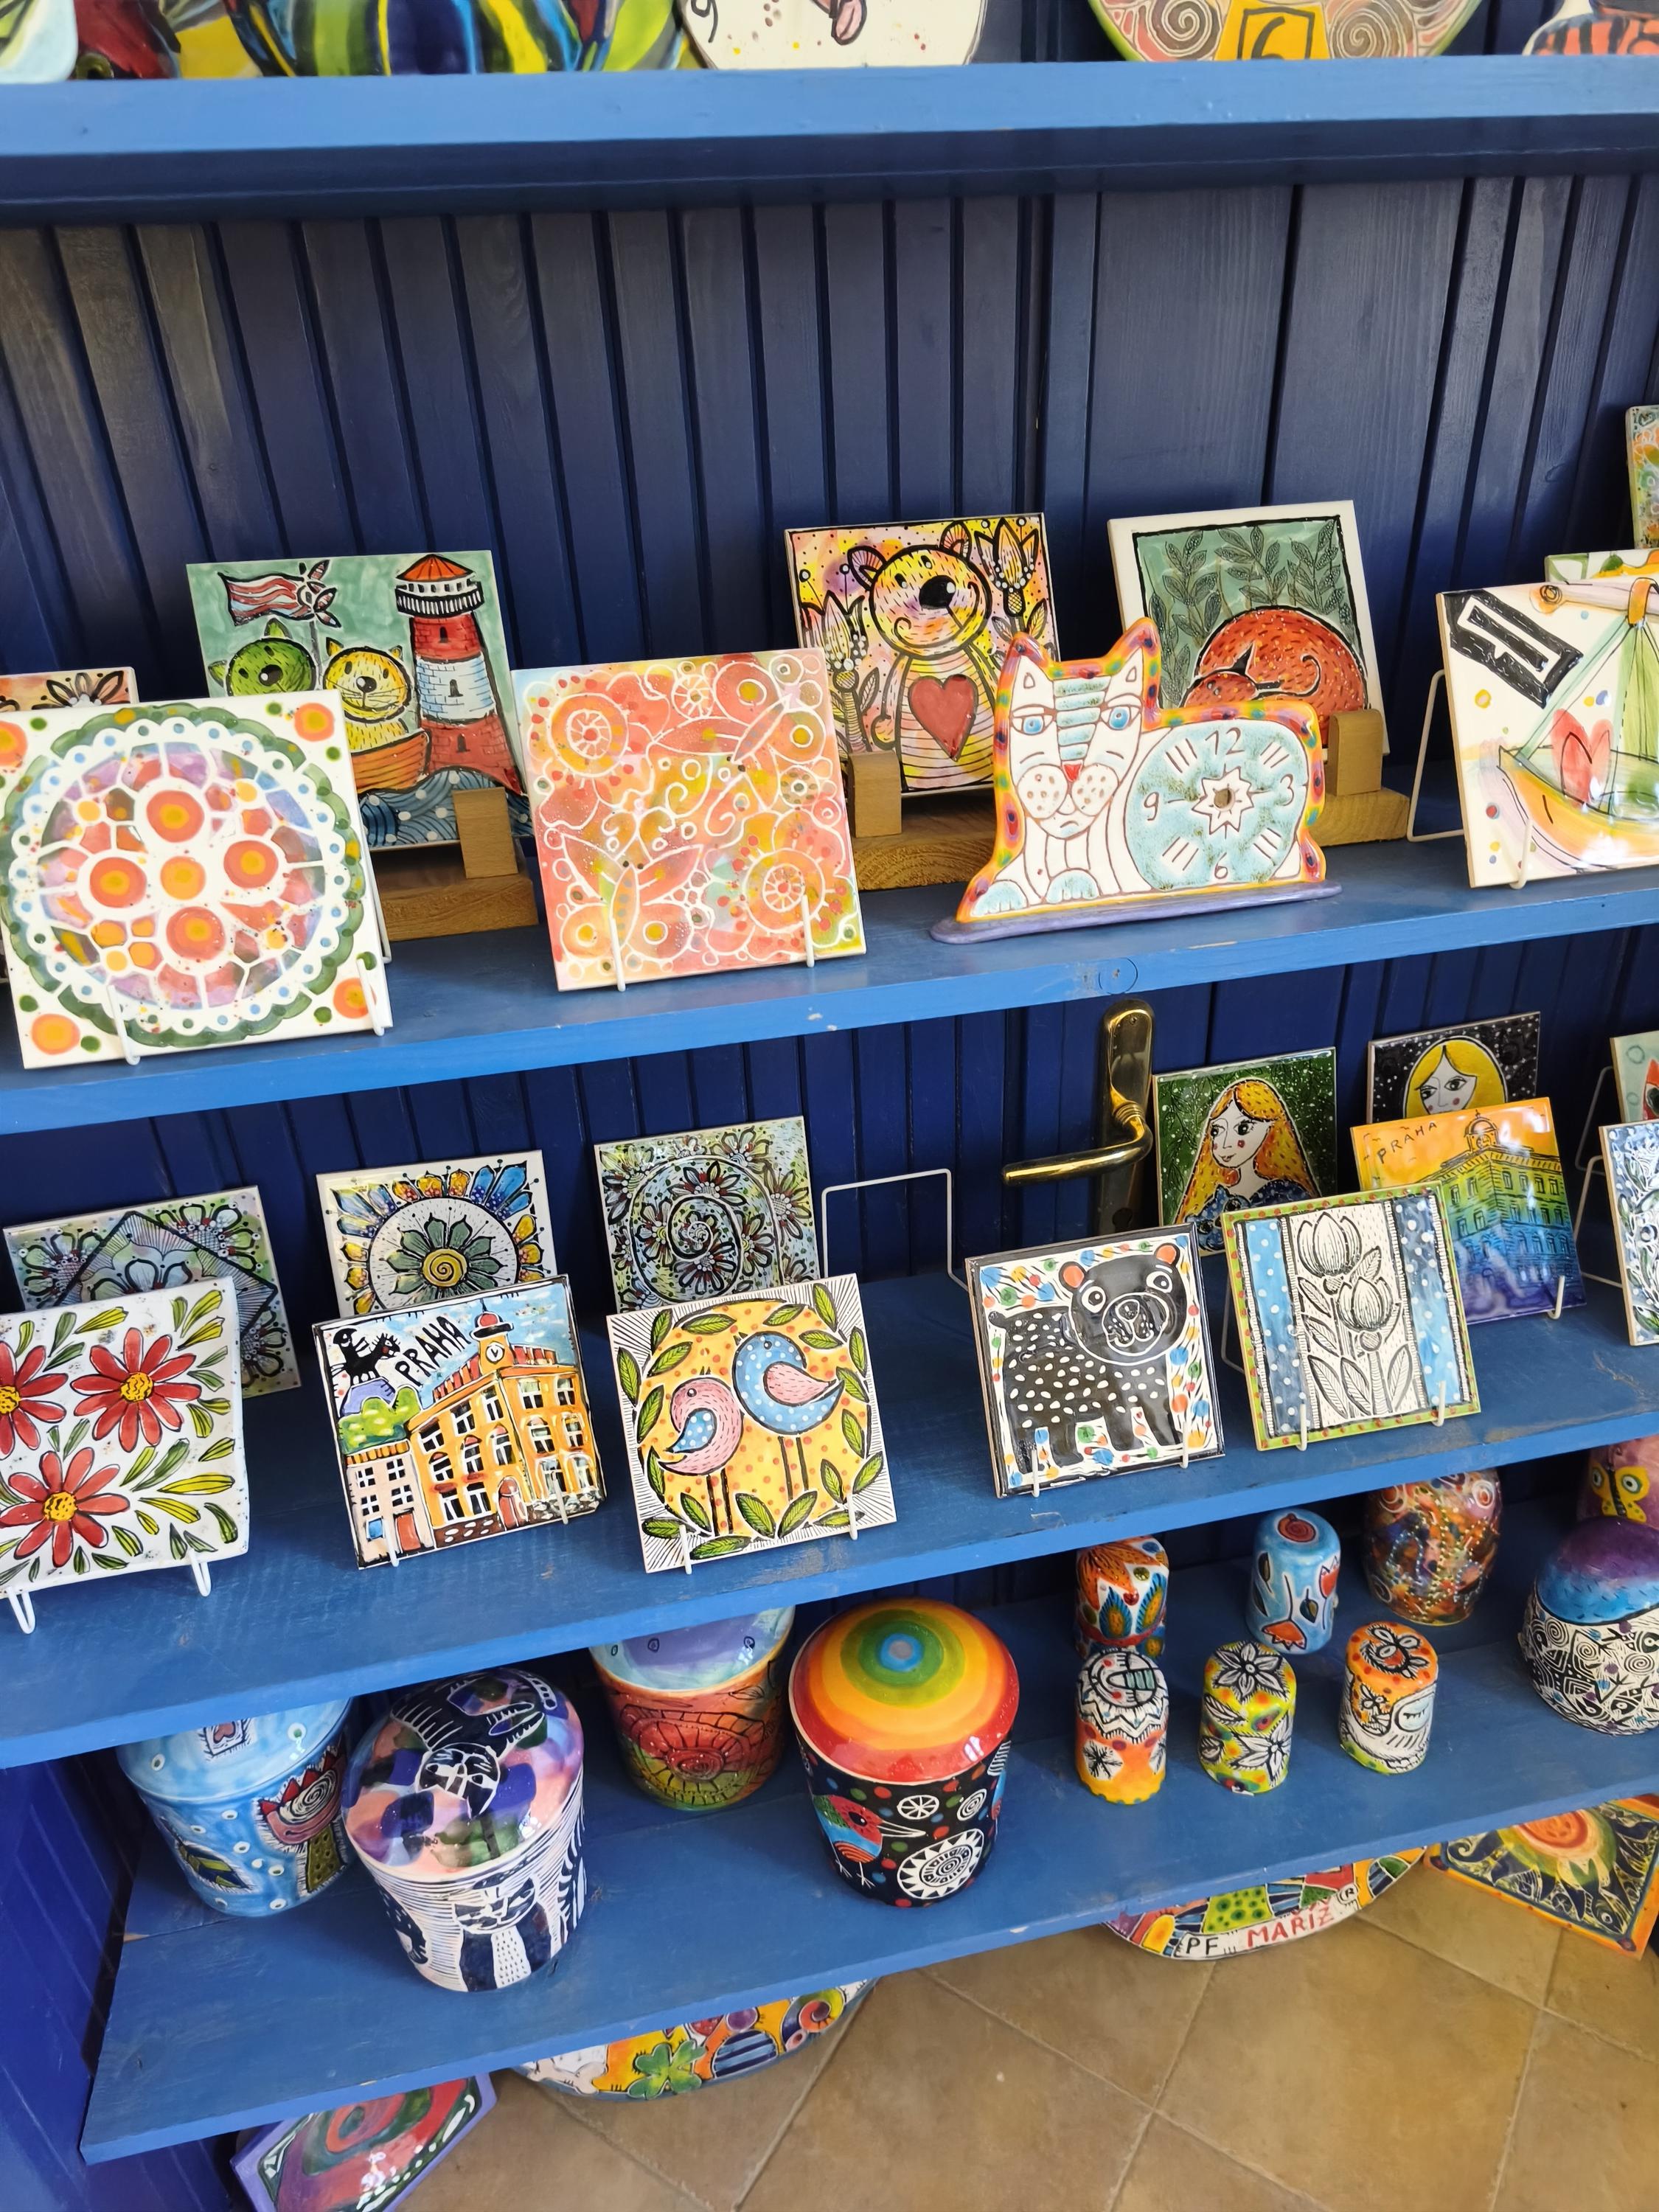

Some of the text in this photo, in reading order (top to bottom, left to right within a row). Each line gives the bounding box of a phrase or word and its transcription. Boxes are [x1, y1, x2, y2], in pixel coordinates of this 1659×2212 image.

[1205, 727, 1245, 755] 12
[1279, 773, 1295, 807] 3
[1144, 791, 1160, 821] 9
[1214, 852, 1228, 880] 6
[1377, 1122, 1437, 1164] PRAHA
[394, 1316, 472, 1387] PRAHA
[1186, 1936, 1218, 1955] PF
